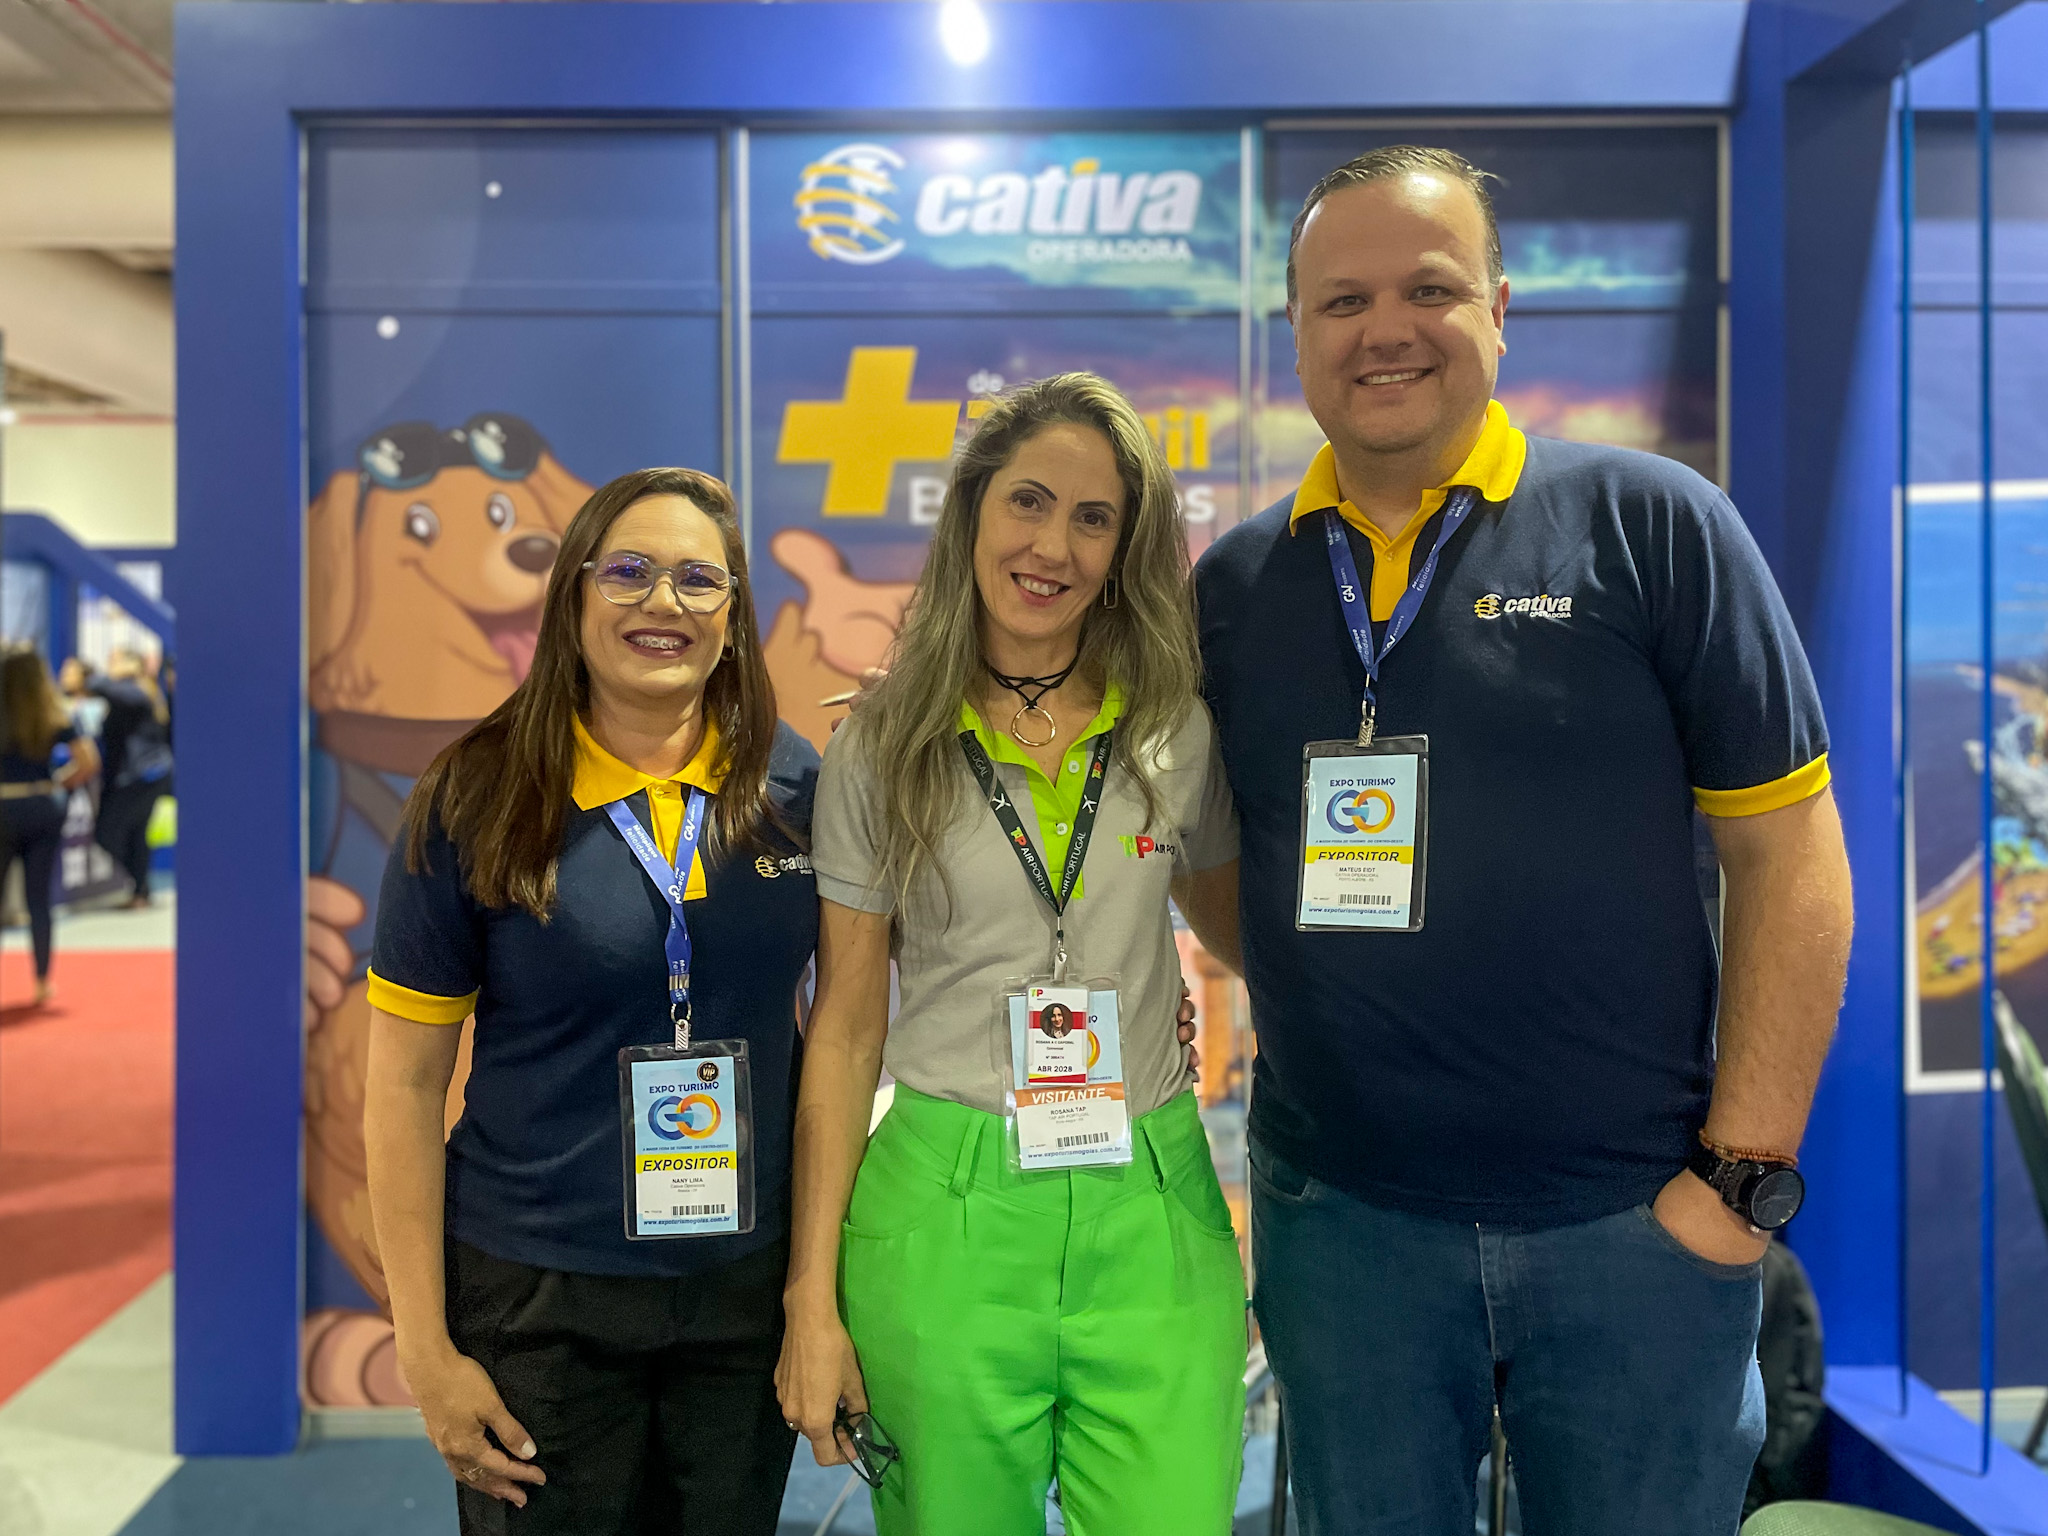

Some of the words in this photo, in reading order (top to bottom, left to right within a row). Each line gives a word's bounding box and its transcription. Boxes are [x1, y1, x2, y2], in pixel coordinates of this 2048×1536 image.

[916, 160, 1201, 235] cativa
[1026, 238, 1193, 264] OPERADORA
[1503, 594, 1573, 613] cativa
[1357, 778, 1396, 786] TURISMO
[1318, 851, 1400, 862] EXPOSITOR
[703, 1067, 716, 1077] VIP
[649, 1086, 675, 1094] EXPO
[679, 1081, 720, 1092] TURISMO
[1032, 1087, 1106, 1105] VISITANTE
[1050, 1107, 1075, 1115] ROSANA
[643, 1157, 730, 1172] EXPOSITOR
